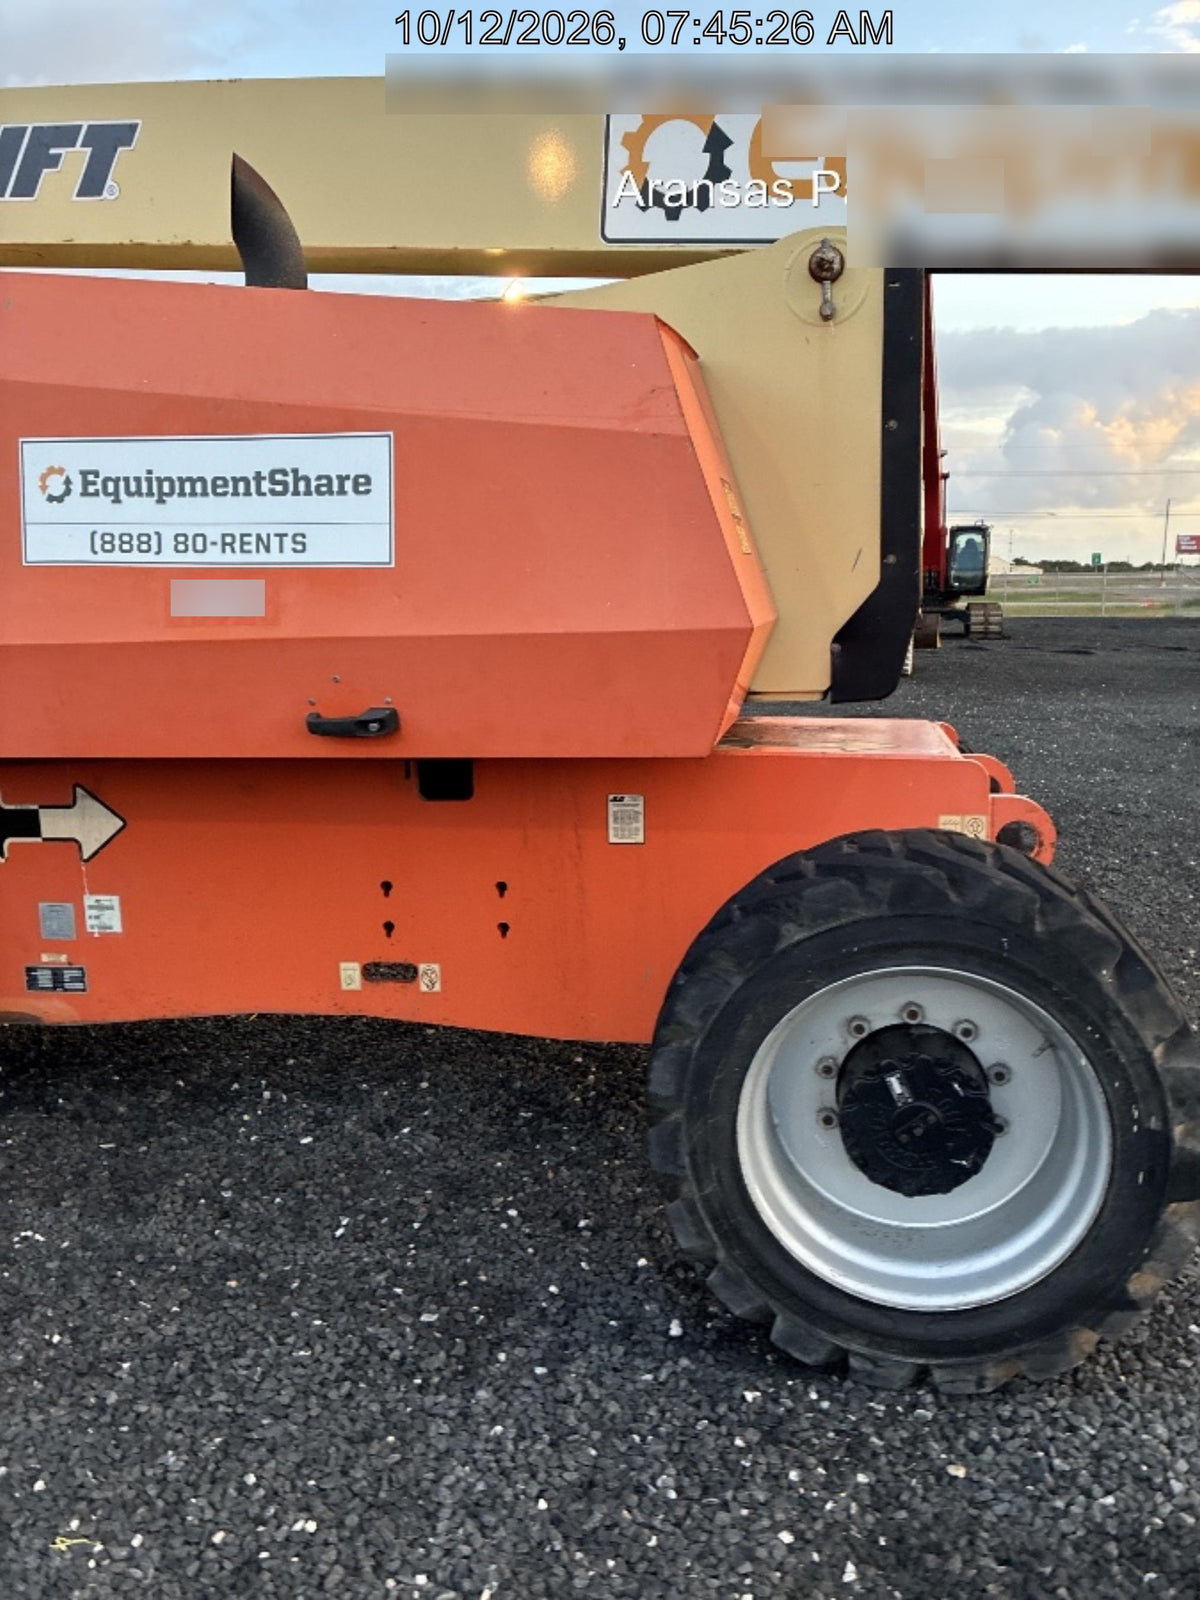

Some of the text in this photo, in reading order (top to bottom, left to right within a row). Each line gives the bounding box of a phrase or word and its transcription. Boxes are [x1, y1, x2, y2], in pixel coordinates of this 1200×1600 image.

[79, 468, 373, 504] EquipmentShare
[90, 531, 308, 555] (888) 80-RENTS
